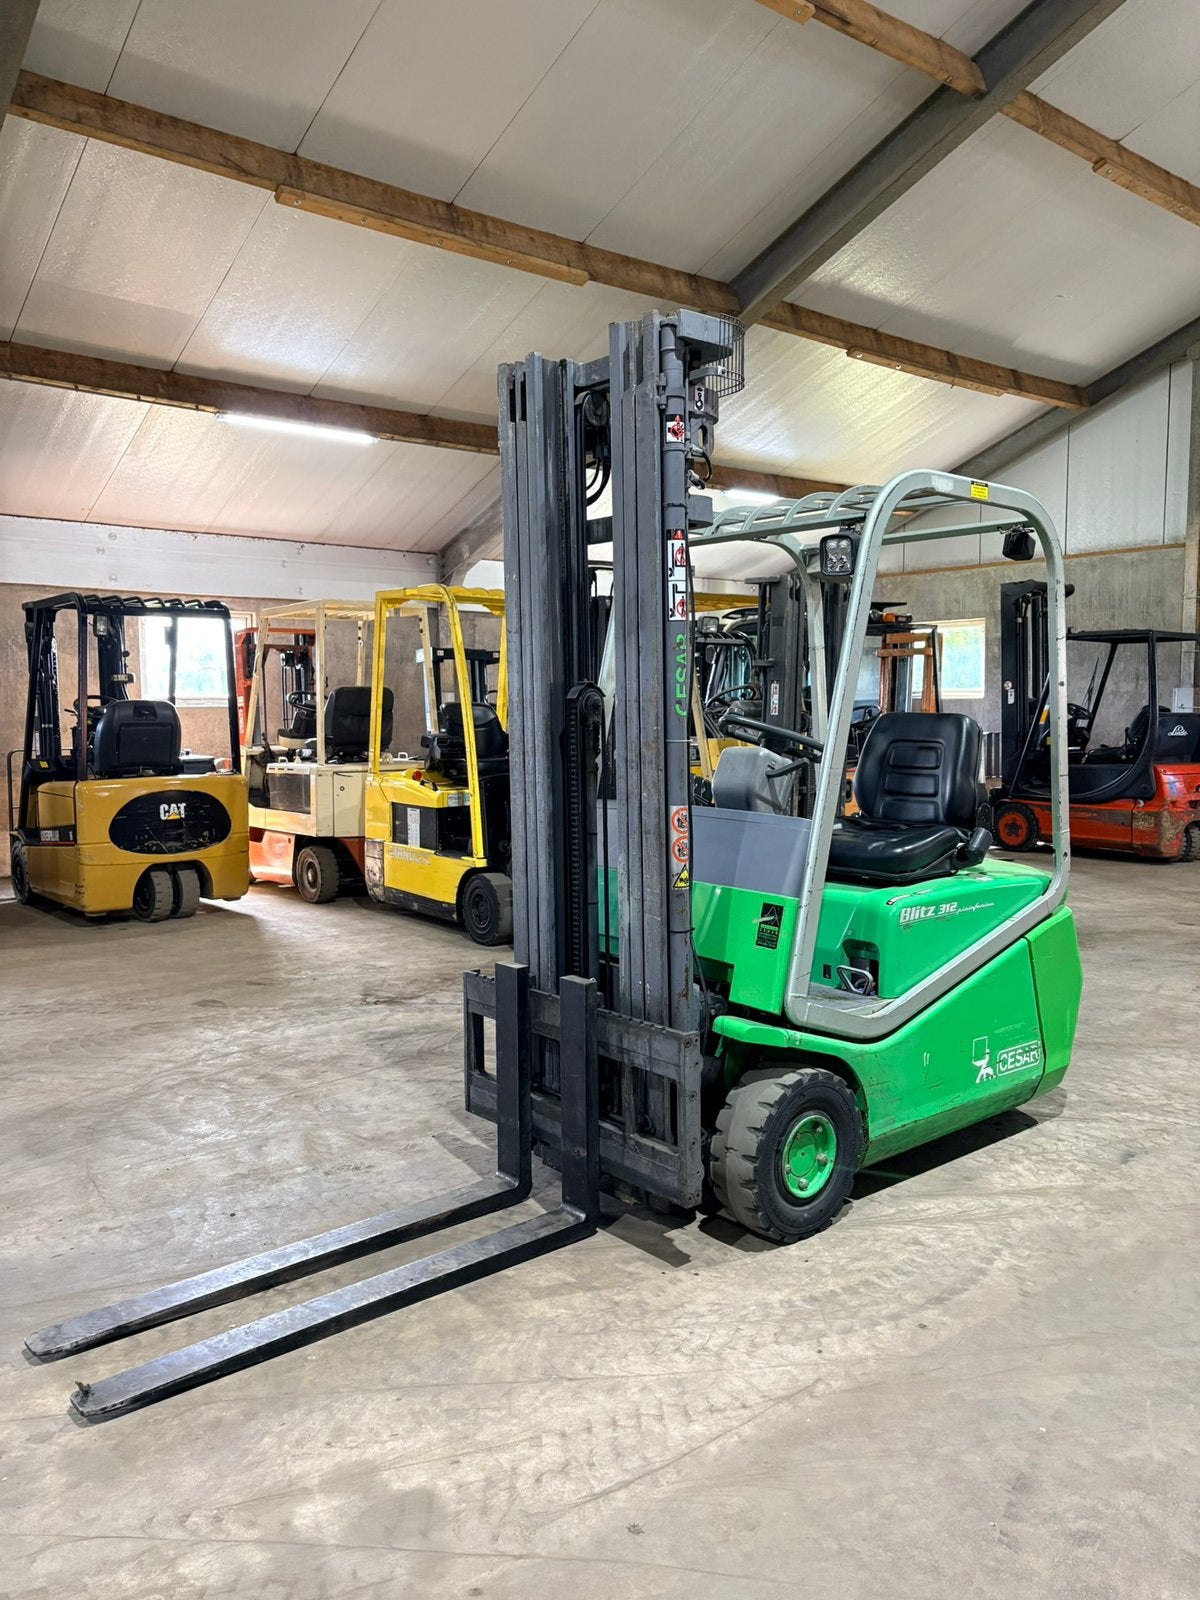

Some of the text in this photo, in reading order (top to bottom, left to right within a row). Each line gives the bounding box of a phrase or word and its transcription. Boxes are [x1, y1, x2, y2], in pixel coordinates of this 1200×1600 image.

[159, 802, 187, 820] CAT
[900, 906, 936, 923] Blitz
[938, 902, 958, 914] 312
